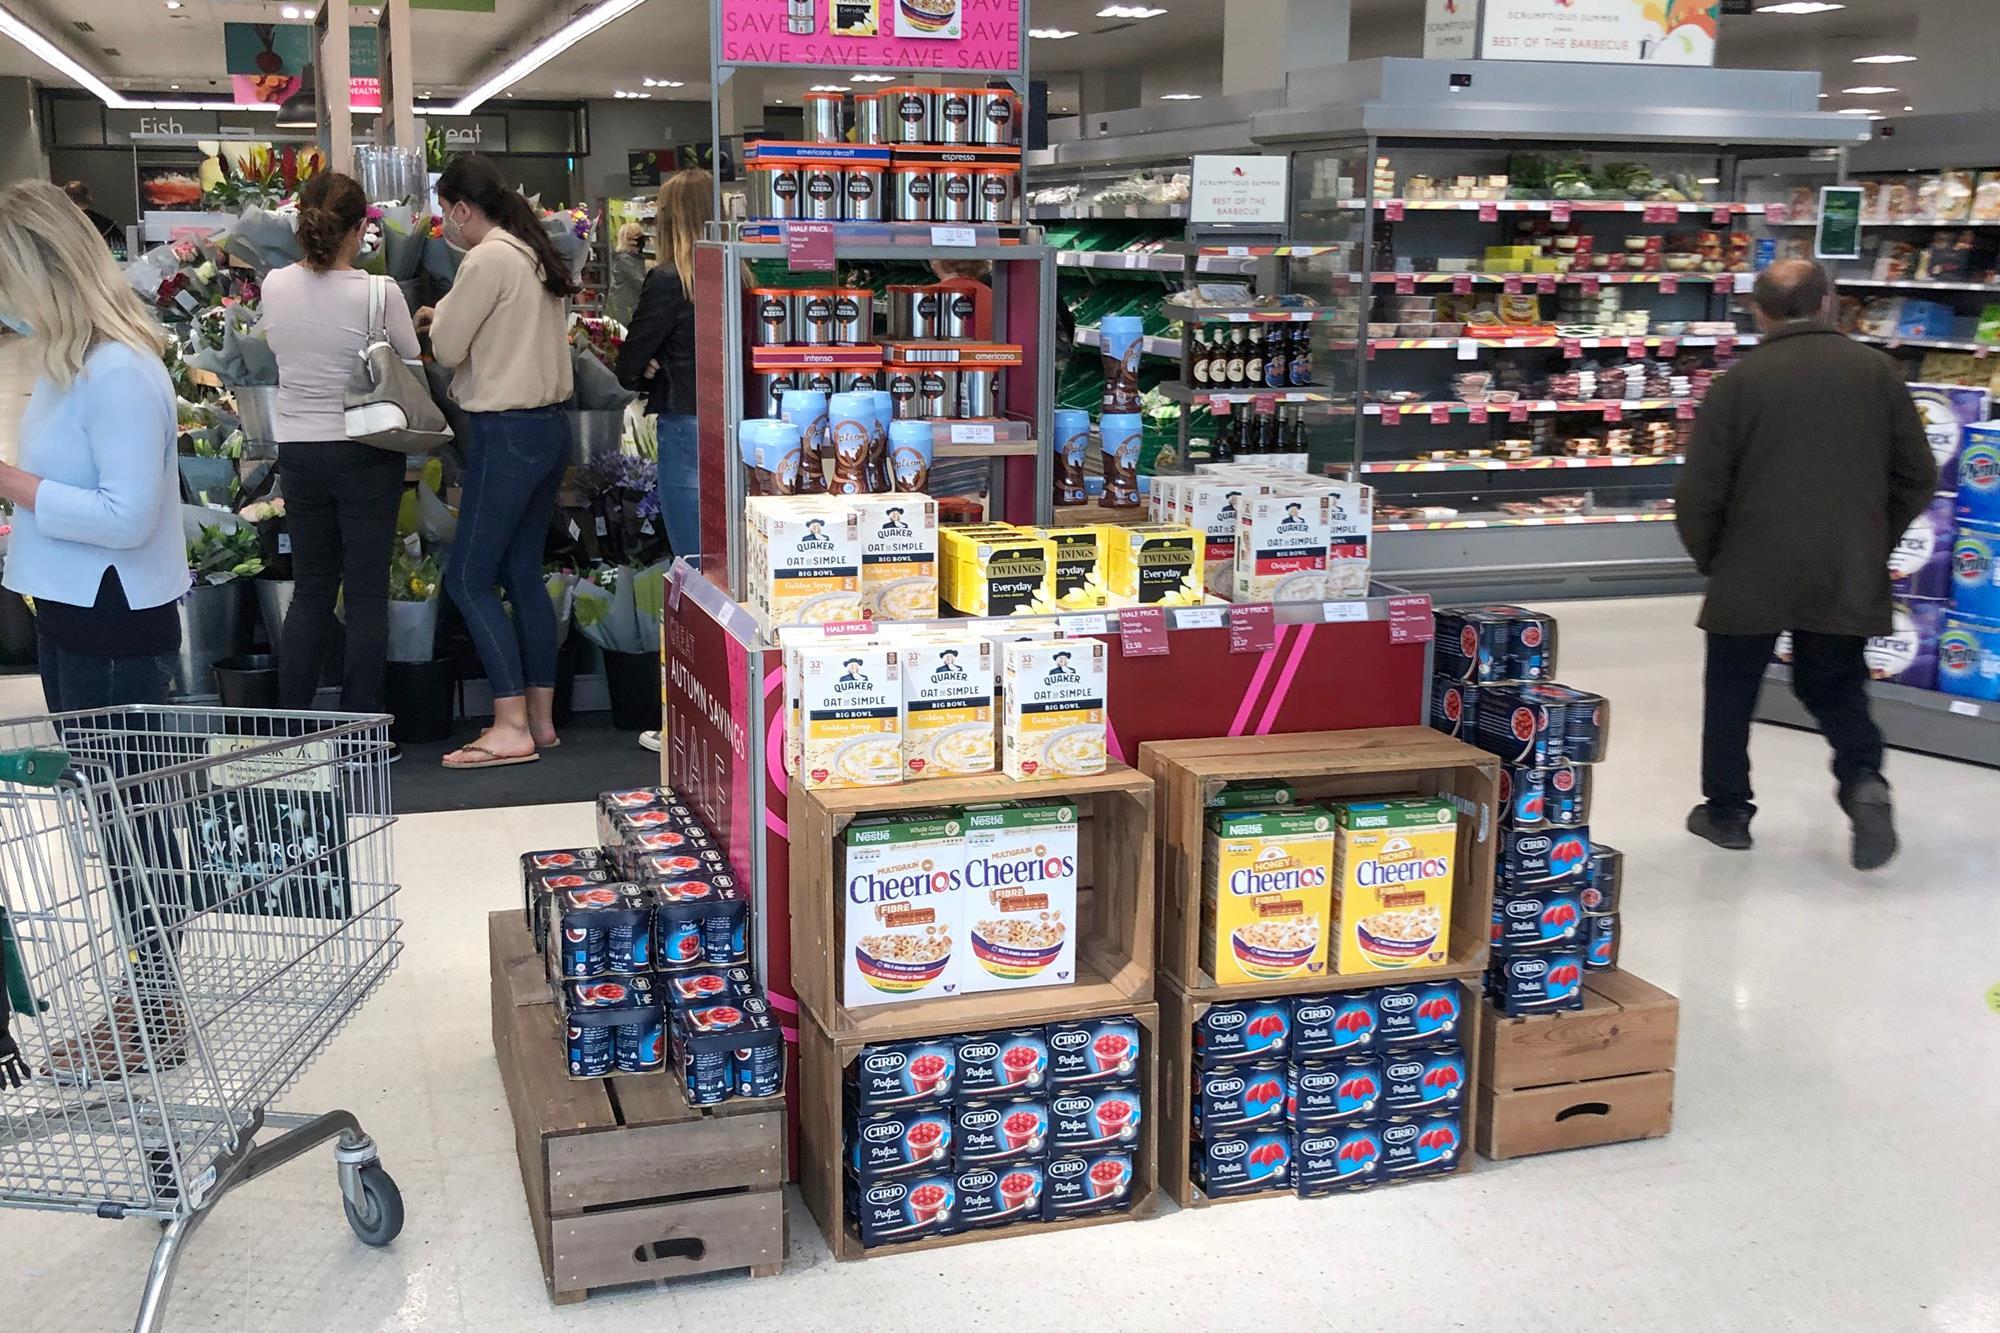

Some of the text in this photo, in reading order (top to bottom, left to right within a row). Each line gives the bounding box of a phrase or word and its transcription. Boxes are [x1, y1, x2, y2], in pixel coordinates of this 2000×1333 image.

[726, 12, 788, 33] SAVE
[961, 19, 1019, 42] SAVE
[1492, 36, 1629, 51] BEST OF THE BARBECUE
[726, 42, 1019, 70] SAVE SAVE SAVE SAVE
[140, 117, 184, 136] Fish
[441, 123, 482, 144] eat
[796, 148, 855, 157] americano decaff
[941, 153, 976, 163] espresso
[790, 225, 828, 233] HALF PRICE
[803, 354, 834, 362] intenso
[975, 352, 1015, 361] americano
[877, 528, 913, 541] QUAKER
[1207, 525, 1223, 534] OAT
[1277, 525, 1309, 534] QUAKER
[1331, 524, 1357, 533] IMPLE
[796, 541, 836, 554] QUAKER
[867, 541, 924, 553] OAT SIMPLE
[1267, 536, 1318, 547] OAT SIMPLE
[786, 555, 847, 567] OAT SIMPLE
[891, 554, 911, 562] BOWL
[1143, 552, 1191, 564] TWININGS
[814, 570, 835, 578] BOWL
[992, 564, 1041, 576] TWININGS
[1143, 568, 1182, 580] Everyday
[992, 581, 1033, 593] Everyday
[1407, 598, 1427, 606] PRICE
[1121, 608, 1160, 618] HALF PRICE
[1231, 606, 1271, 616] HALF PRICE
[826, 622, 867, 633] HALF PRICE
[670, 615, 696, 664] GREAT
[931, 672, 968, 684] QUAKER
[1044, 674, 1081, 686] QUAKER
[834, 681, 874, 693] QUAKER
[920, 685, 980, 698] OAT SIMPLE
[1033, 688, 1092, 701] OAT SIMPLE
[670, 655, 745, 761] AUTUMN SAVINGS
[823, 695, 886, 708] OAT SIMPLE
[1060, 703, 1081, 711] BOWL
[835, 710, 874, 719] BIG BOWL
[1022, 811, 1039, 819] Whole
[1041, 810, 1057, 819] Grain
[909, 826, 926, 834] Whole
[927, 825, 945, 834] Grain
[205, 840, 329, 862] WATROSE
[991, 846, 1032, 860] MULTIGRAIN
[1380, 849, 1417, 862] HONEY
[877, 861, 919, 875] MULTIGRAIN
[965, 855, 1074, 889] Cheerios
[1254, 858, 1292, 873] HONEY
[1356, 855, 1447, 887] Cheerios
[850, 868, 961, 904] Cheerios
[1230, 864, 1325, 896] Cheerios
[996, 888, 1024, 899] FIBRE
[881, 902, 911, 914] FIBRE
[1383, 996, 1416, 1009] CIRIO
[1211, 1012, 1245, 1026] CIRIO
[1300, 1007, 1333, 1020] CIRIO
[1054, 1032, 1088, 1046] CIRIO
[963, 1044, 997, 1059] CIRIO
[869, 1055, 903, 1069] CIRIO
[1057, 1054, 1084, 1068] Polpa
[965, 1066, 993, 1080] Polpa
[1390, 1064, 1422, 1077] CIRIO
[872, 1076, 900, 1090] Polpa
[1209, 1079, 1242, 1093] CIRIO
[1303, 1075, 1336, 1088] CIRIO
[1057, 1098, 1090, 1112] CIRIO
[963, 1111, 997, 1126] CIRIO
[867, 1123, 901, 1138] CIRIO
[1060, 1119, 1087, 1133] Polpa
[967, 1133, 994, 1147] Polpa
[1385, 1127, 1417, 1140] CIRIO
[871, 1145, 898, 1159] Polpa
[1213, 1143, 1247, 1157] CIRIO
[1304, 1139, 1337, 1152] CIRIO
[1050, 1160, 1084, 1174] CIRIO
[960, 1173, 994, 1188] CIRIO
[871, 1186, 904, 1200] CIRIO
[1054, 1182, 1080, 1196] Polpa
[964, 1194, 991, 1209] Polpa
[873, 1207, 901, 1222] Polpa
